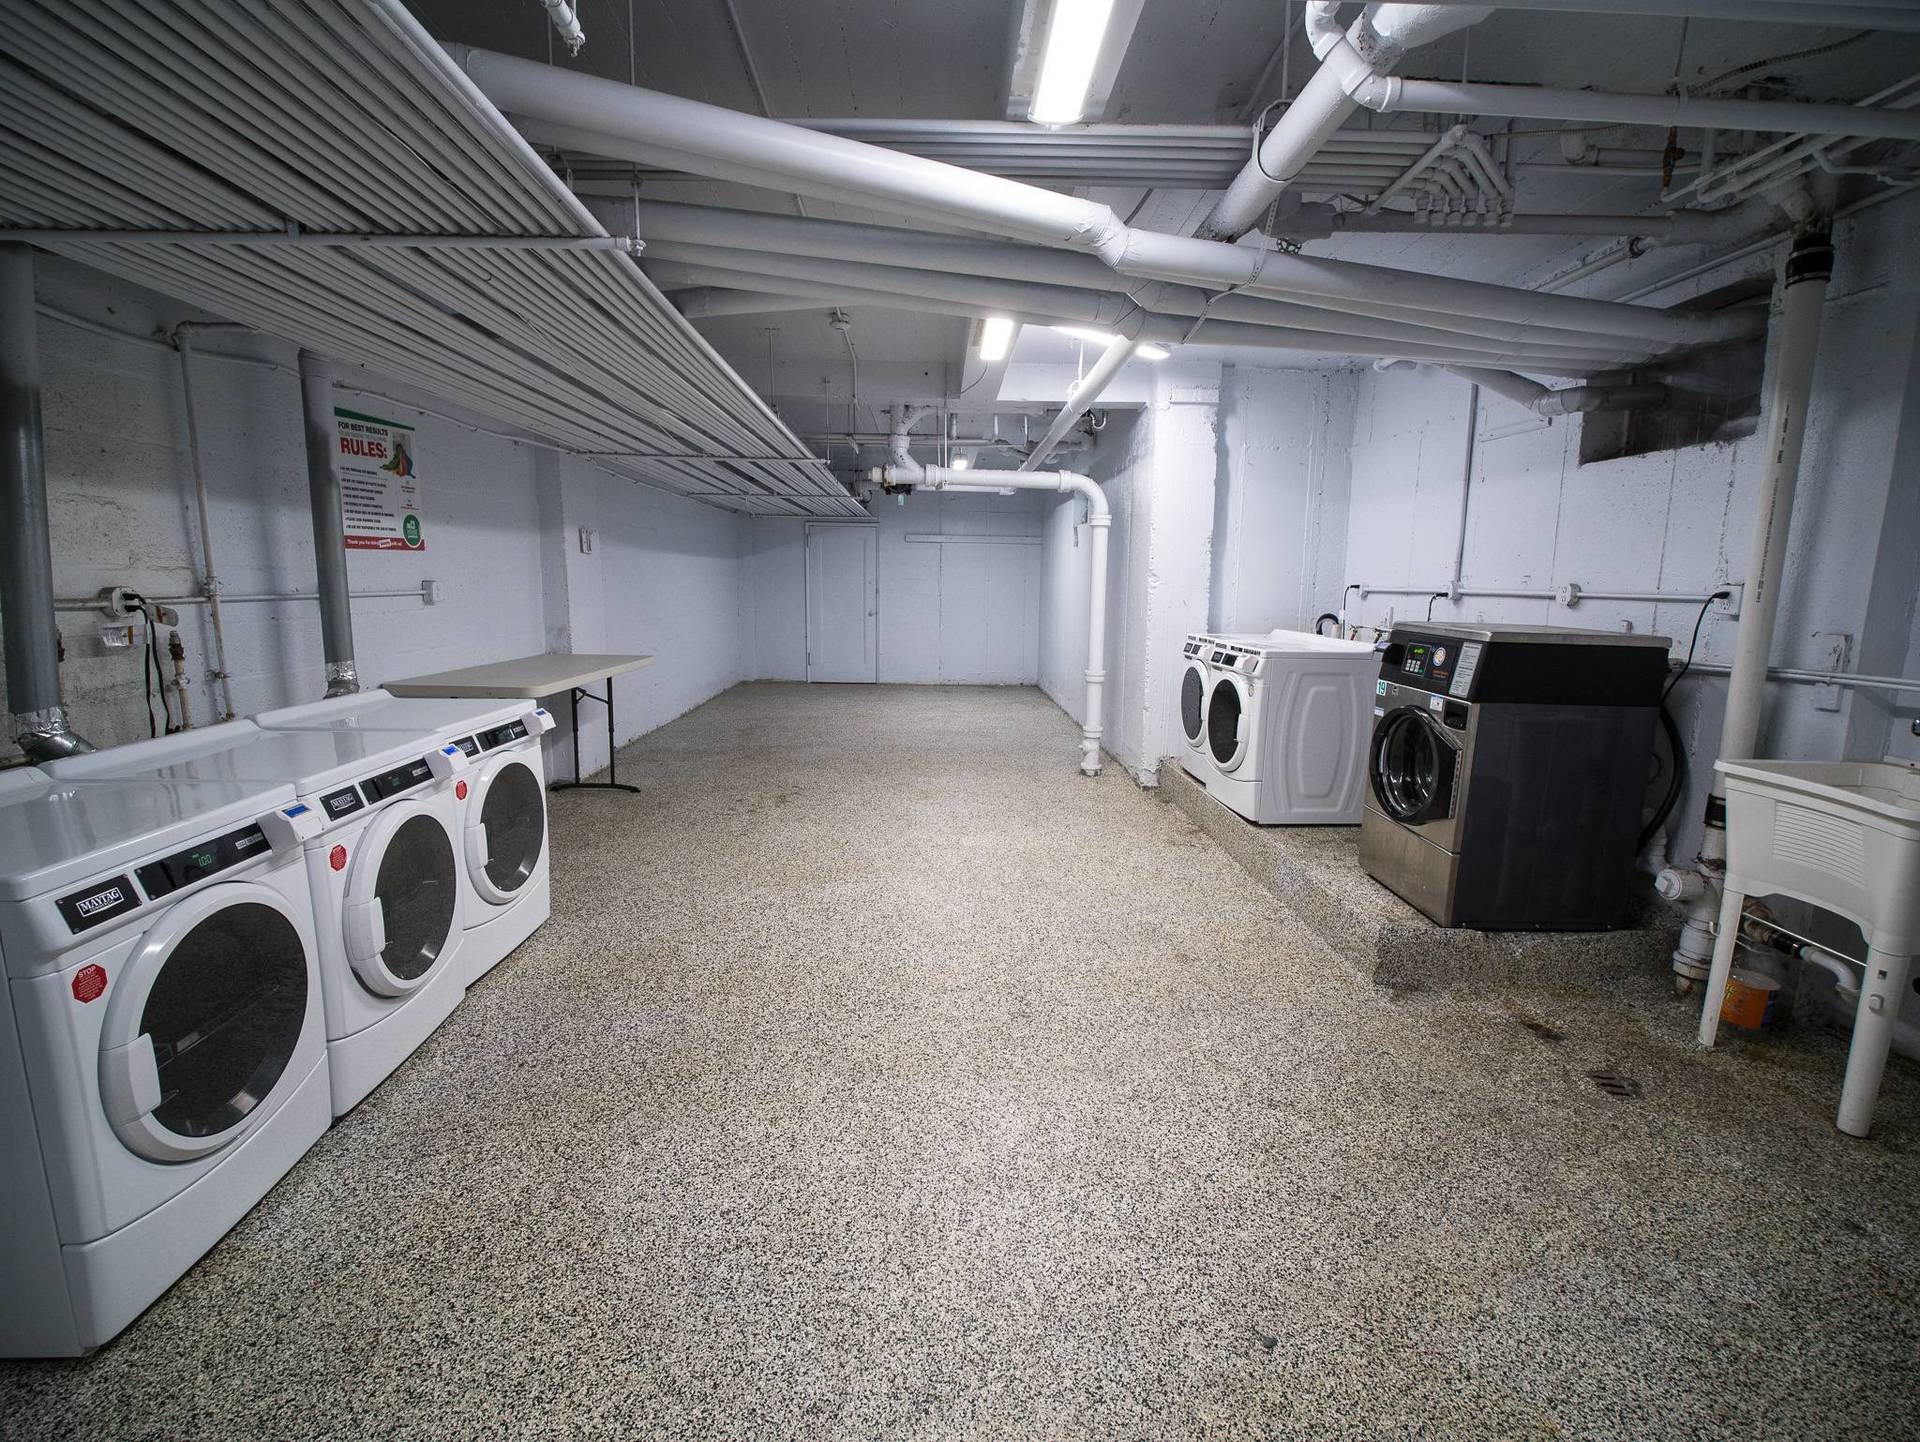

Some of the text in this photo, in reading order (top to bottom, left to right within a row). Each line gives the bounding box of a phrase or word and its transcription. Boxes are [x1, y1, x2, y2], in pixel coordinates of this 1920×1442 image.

[338, 421, 350, 430] FOR
[351, 423, 364, 433] BEST
[340, 437, 388, 459] RULES:
[80, 890, 119, 911] MAYTAG
[79, 965, 96, 978] STOP
